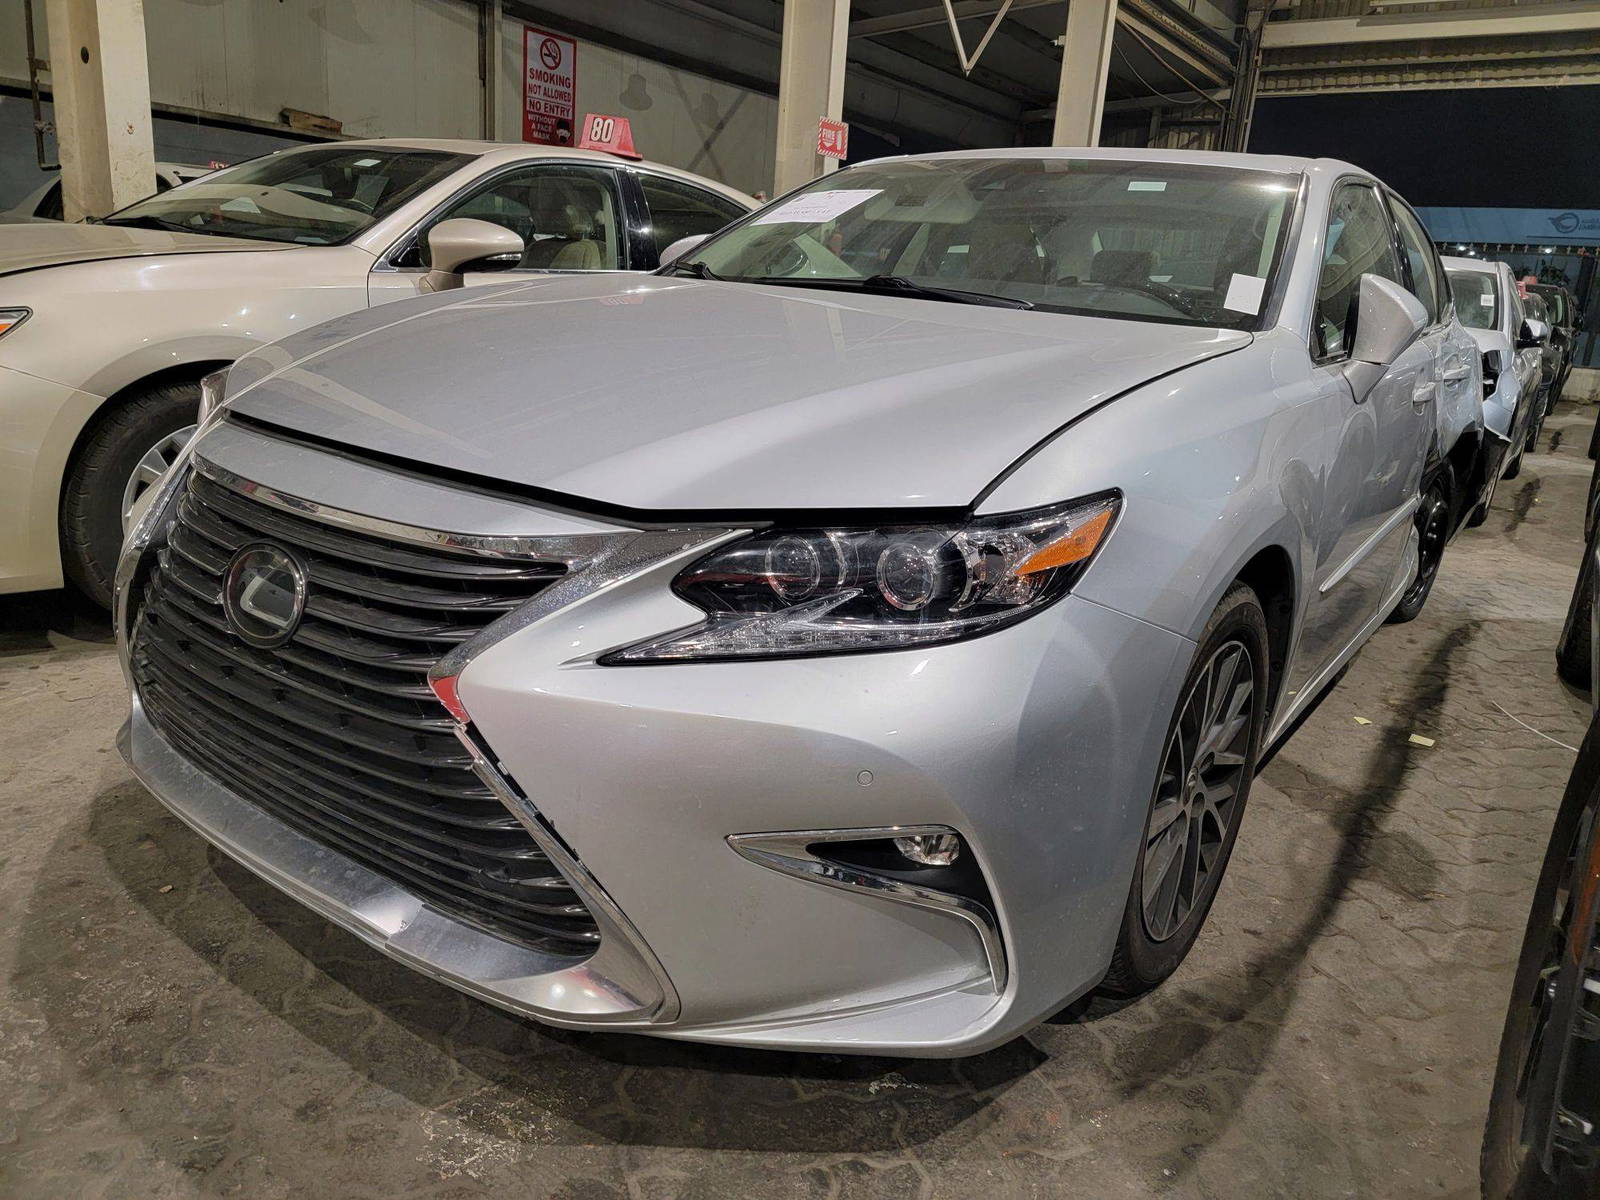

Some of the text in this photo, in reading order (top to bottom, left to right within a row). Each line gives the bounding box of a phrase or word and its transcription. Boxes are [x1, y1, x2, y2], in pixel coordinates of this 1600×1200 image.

[529, 68, 570, 88] SMOKING
[528, 84, 570, 102] NOT ALLOWED
[529, 99, 570, 117] NO ENTRY
[528, 114, 556, 124] WITHOUT
[531, 122, 536, 130] A
[591, 117, 614, 142] 80
[822, 128, 835, 140] FIRE
